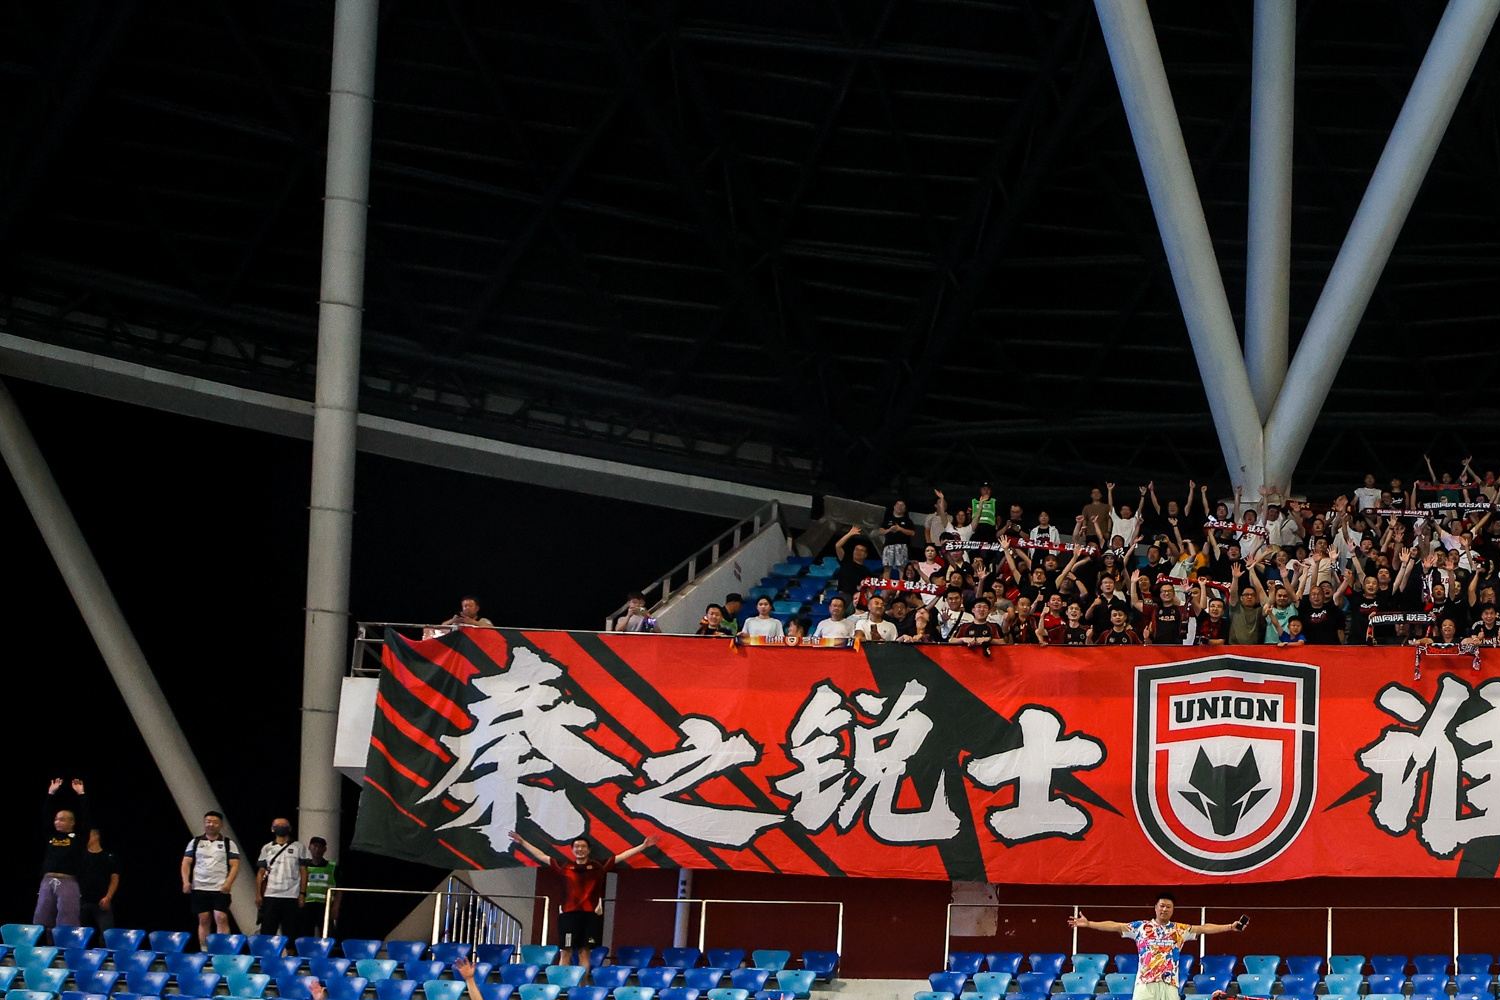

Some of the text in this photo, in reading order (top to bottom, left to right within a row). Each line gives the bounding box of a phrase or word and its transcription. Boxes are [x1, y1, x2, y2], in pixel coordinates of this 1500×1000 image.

[420, 646, 1105, 853] 秦之锐士
[1173, 697, 1282, 724] UNION
